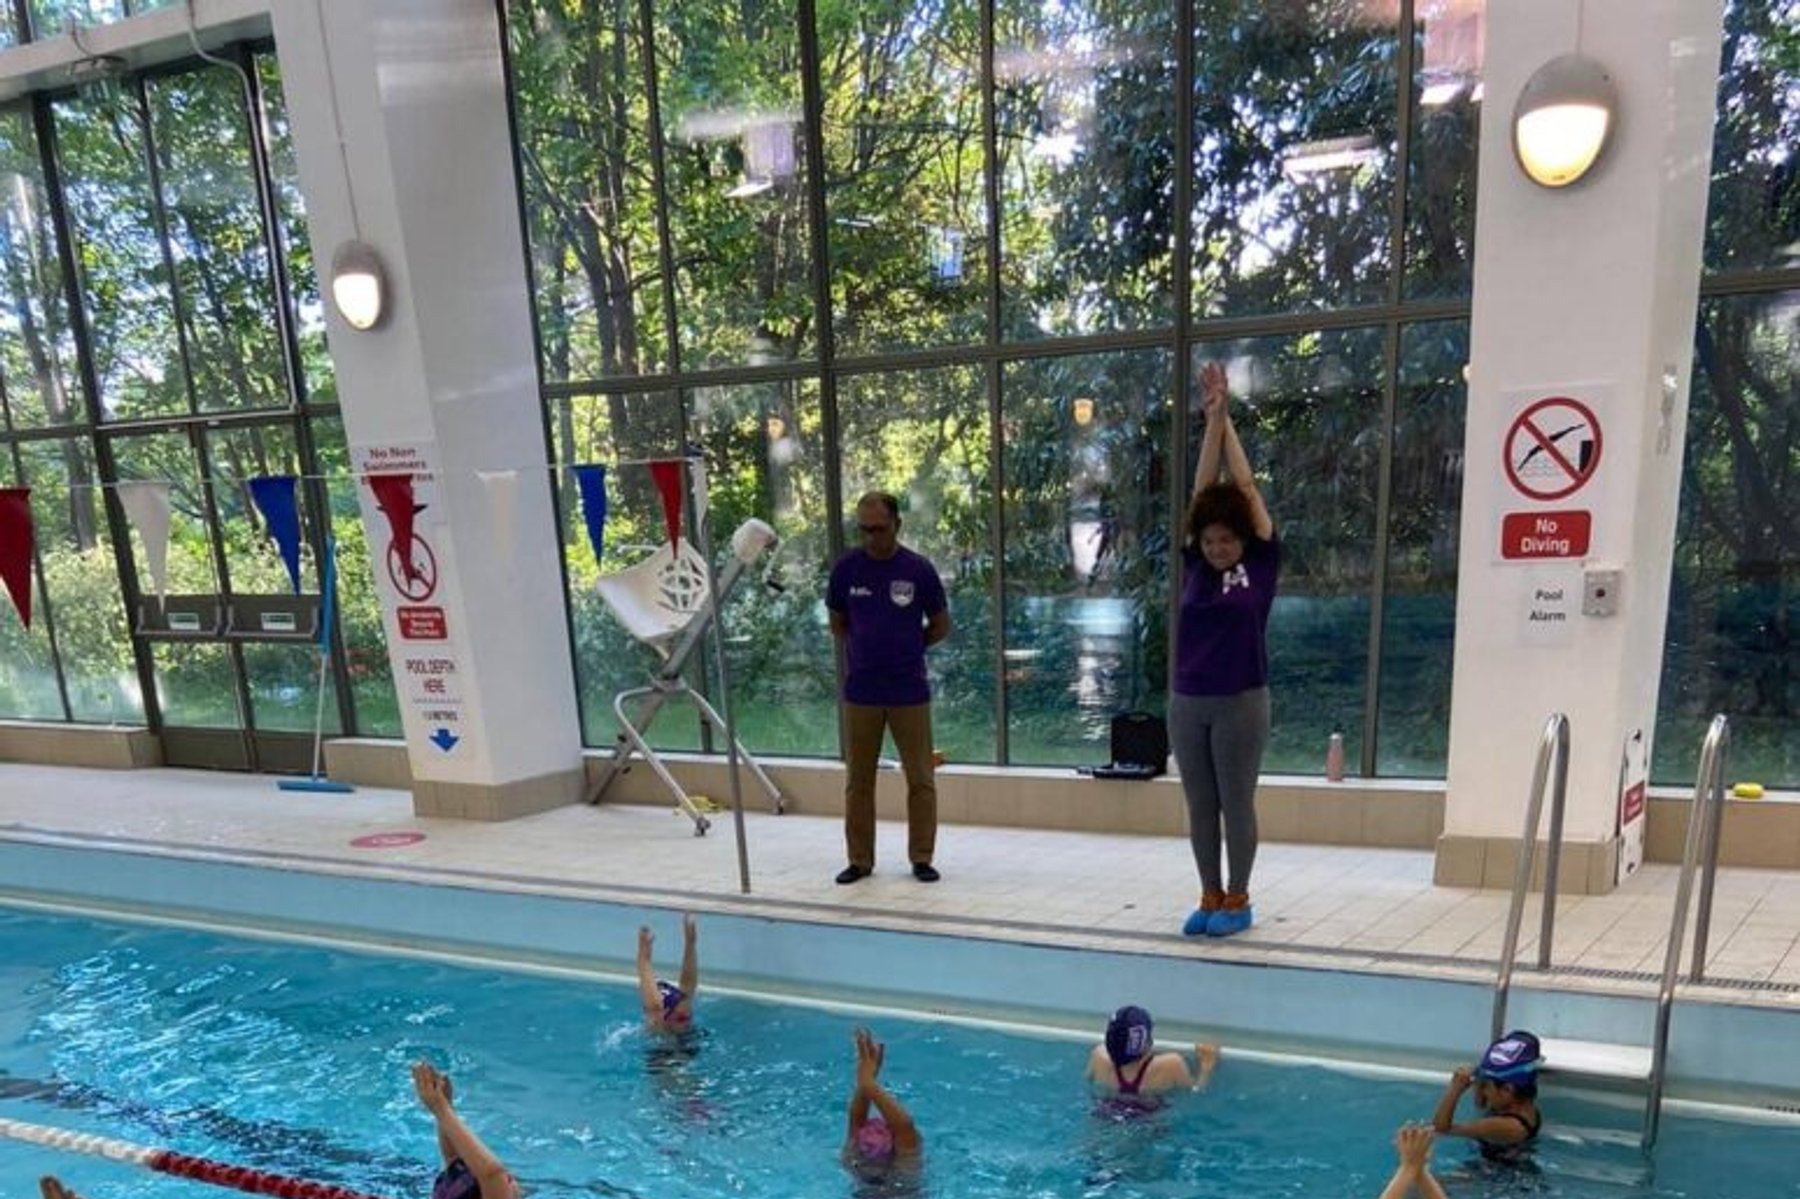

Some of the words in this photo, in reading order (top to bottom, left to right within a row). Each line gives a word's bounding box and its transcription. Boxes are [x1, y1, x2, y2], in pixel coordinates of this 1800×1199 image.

[1534, 518, 1558, 533] No
[1520, 537, 1571, 555] Diving
[1535, 588, 1564, 601] Pool
[1528, 609, 1567, 621] Alarm
